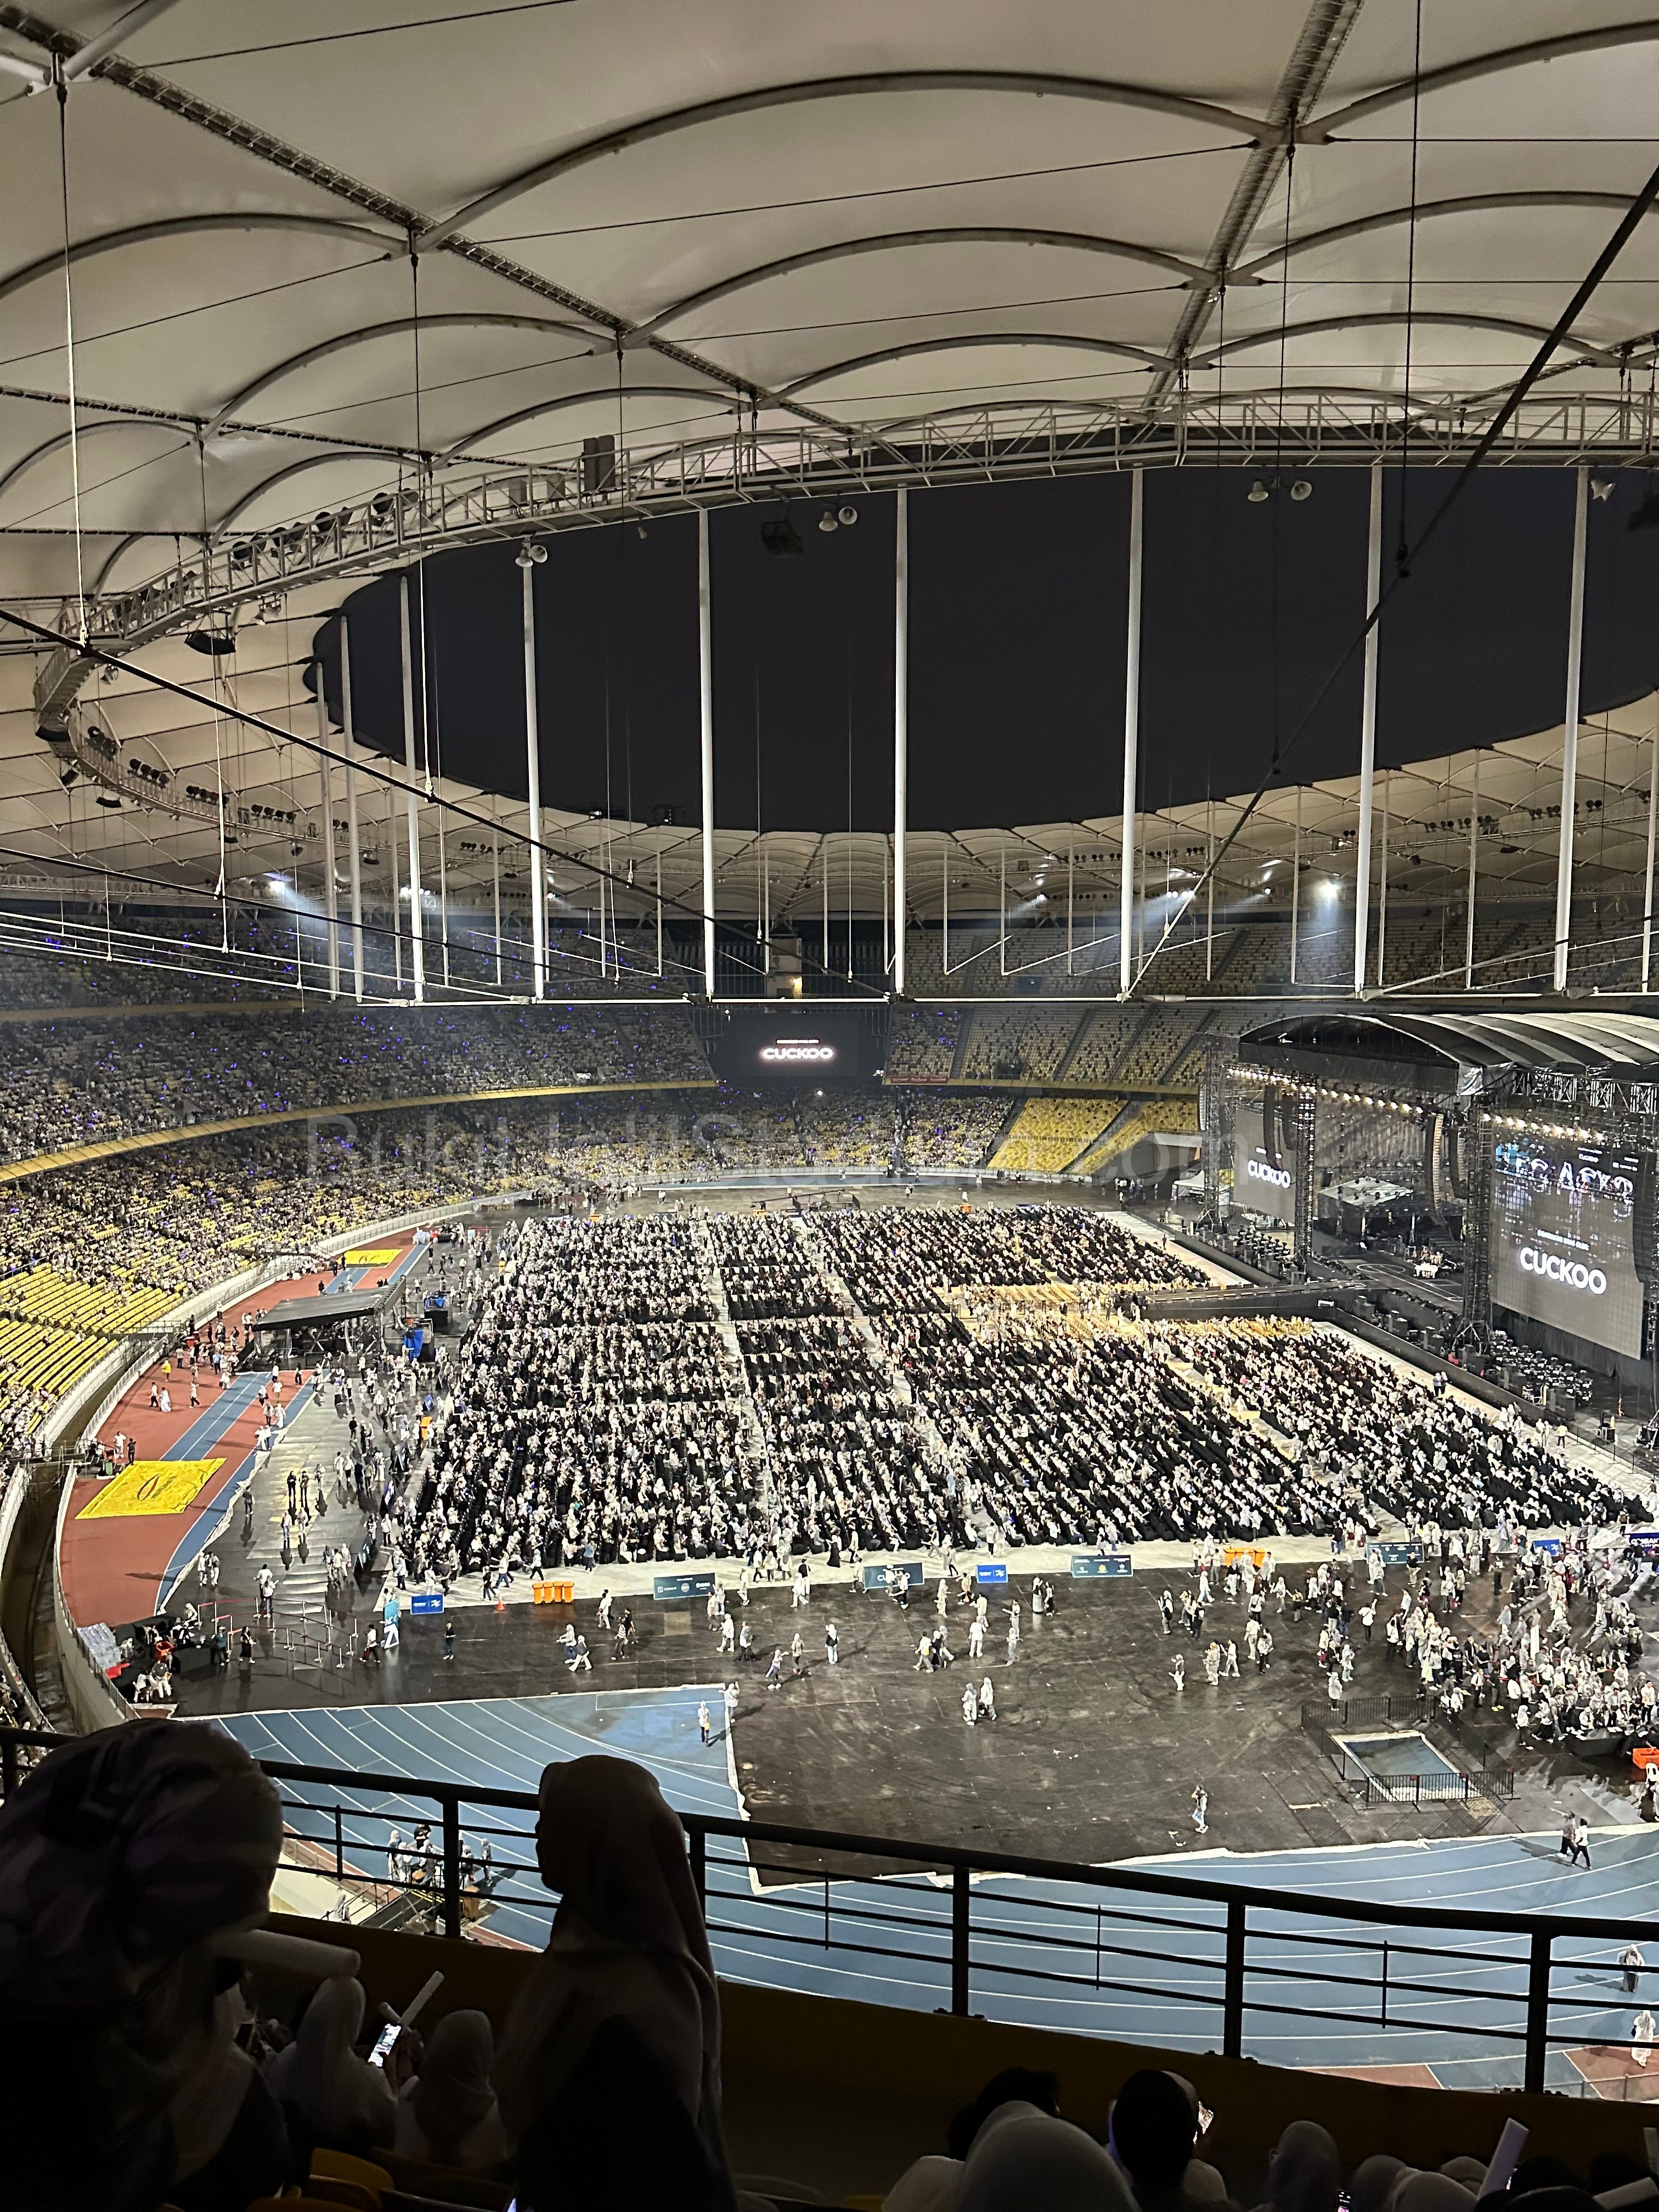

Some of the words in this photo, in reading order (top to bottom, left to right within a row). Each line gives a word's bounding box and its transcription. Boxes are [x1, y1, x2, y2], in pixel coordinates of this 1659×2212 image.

[763, 1047, 833, 1059] CUCKOO
[1248, 1160, 1291, 1188] CUCKOO
[1520, 1247, 1606, 1295] CUCKOO
